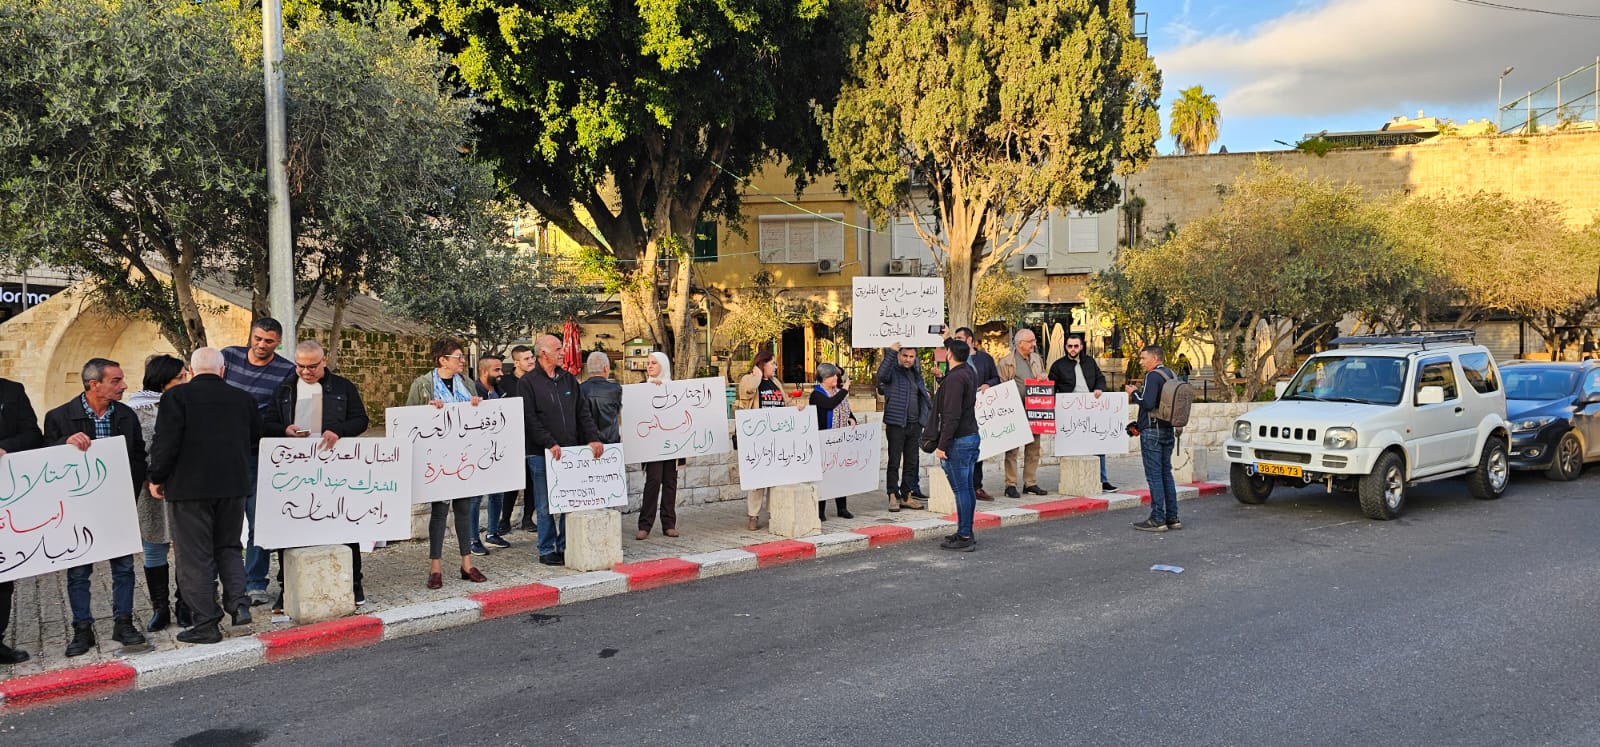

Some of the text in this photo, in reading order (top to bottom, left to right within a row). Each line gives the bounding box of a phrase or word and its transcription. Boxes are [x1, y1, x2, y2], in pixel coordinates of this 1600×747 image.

[652, 384, 712, 410] الاحتلال
[1026, 386, 1053, 396] الاحتلال
[1027, 410, 1054, 420] הכיבוש
[270, 442, 400, 467] النضال العربي اليهودي
[561, 455, 574, 470] כל
[576, 459, 590, 469] את
[271, 467, 398, 494] المشترك ضد الحرب
[345, 500, 389, 525] واجب
